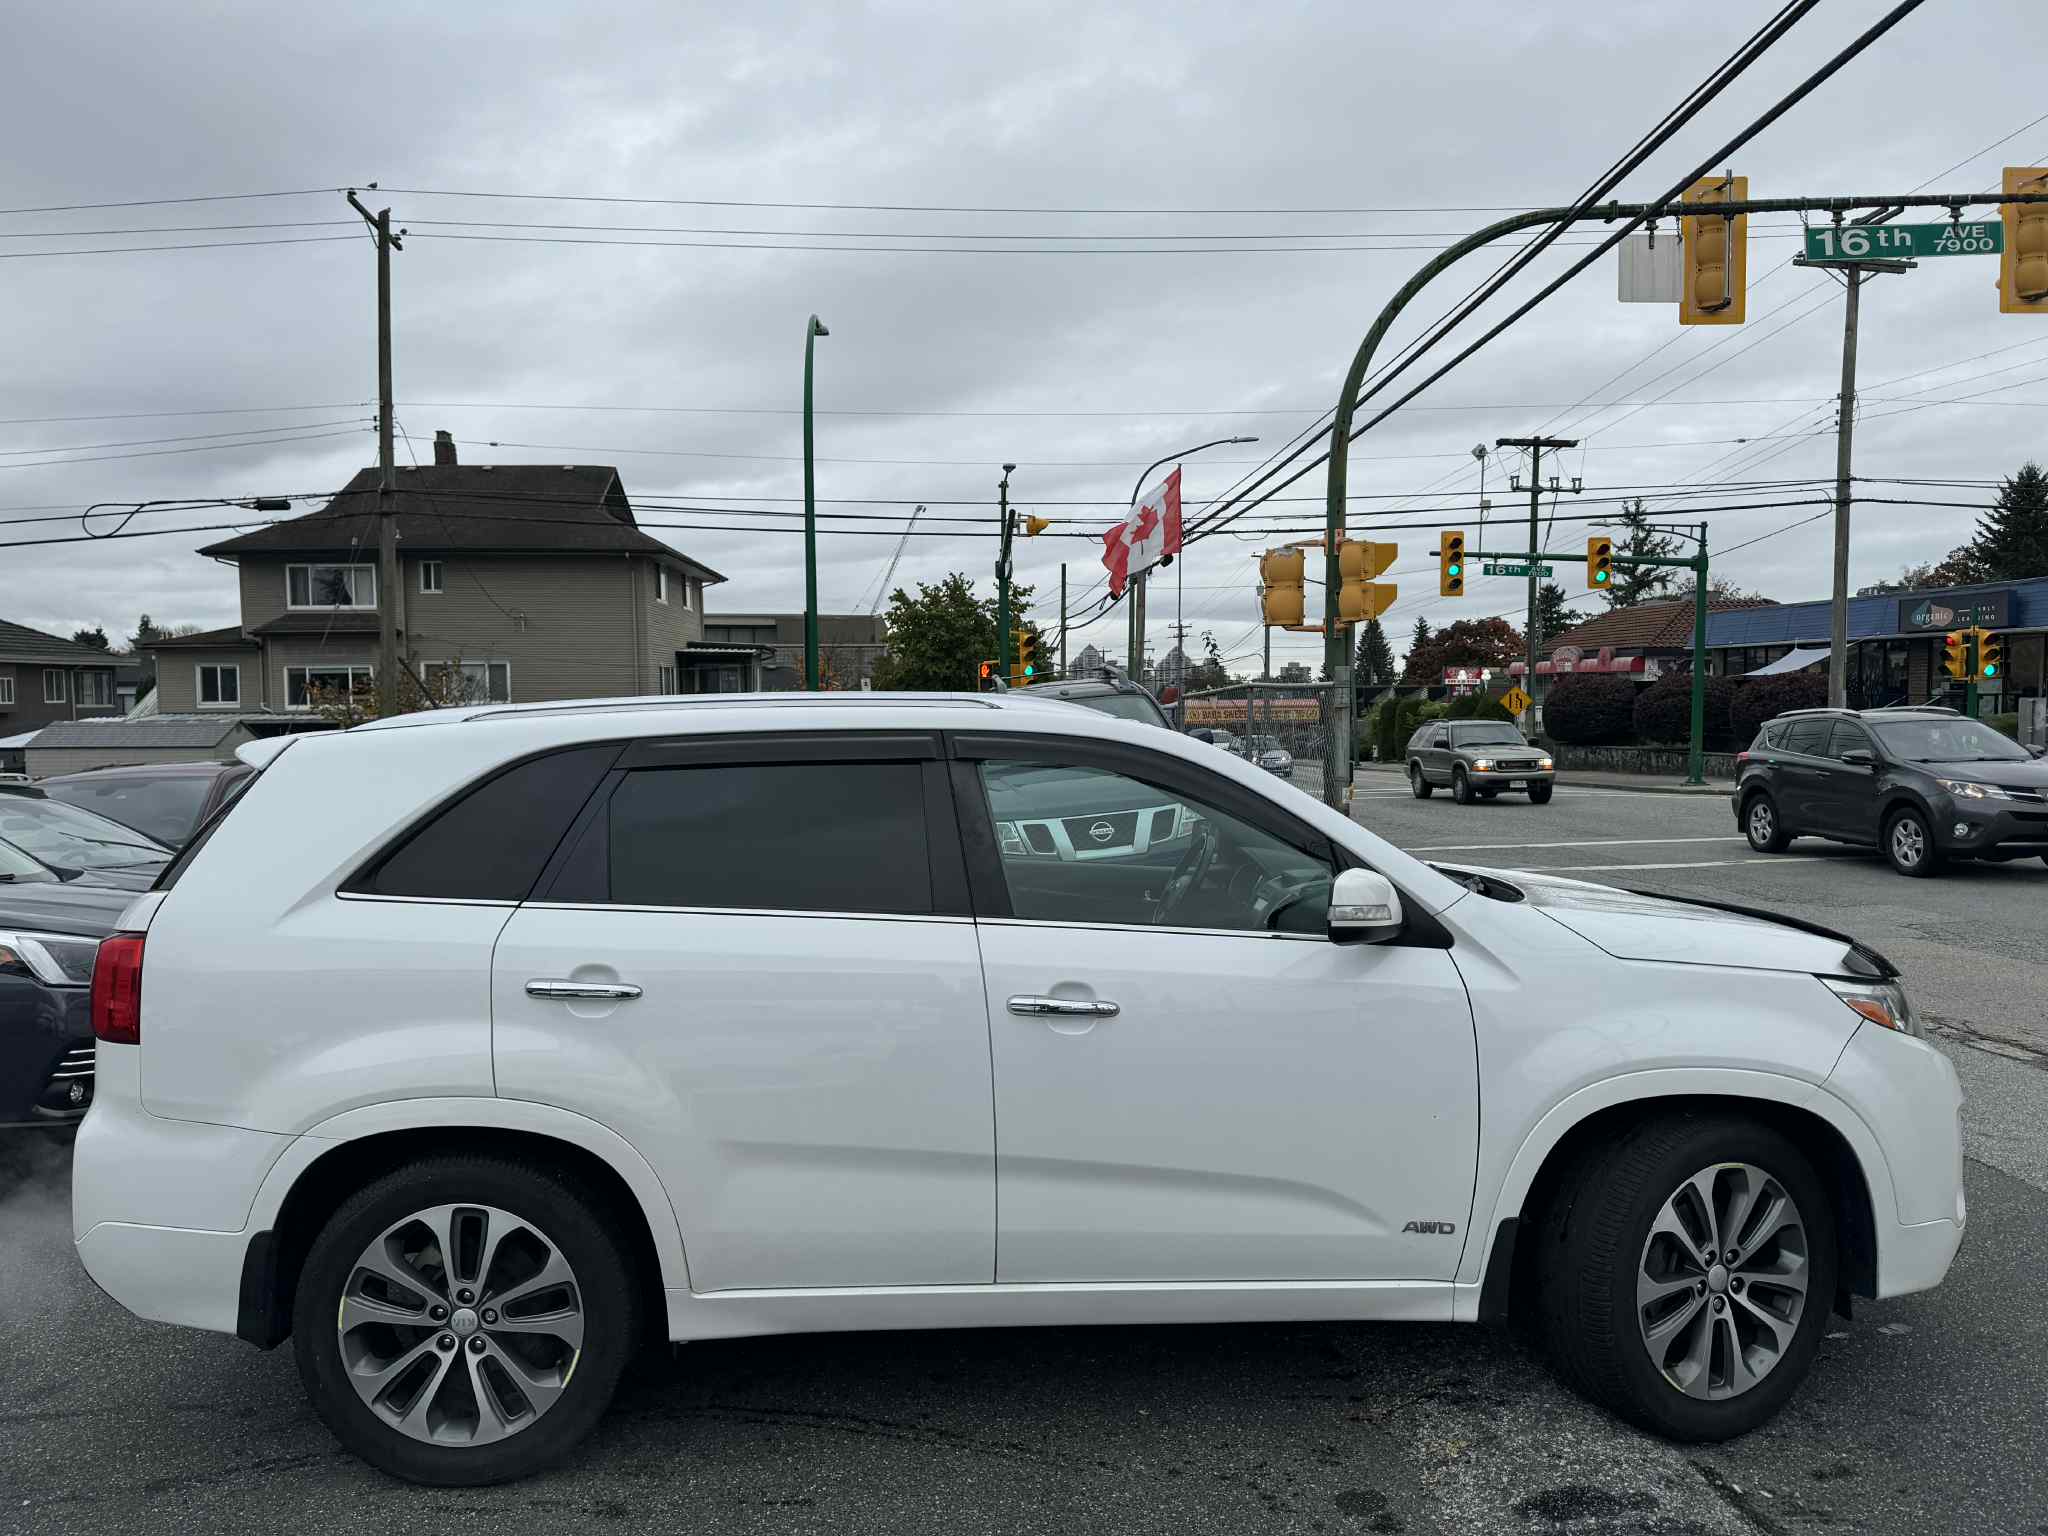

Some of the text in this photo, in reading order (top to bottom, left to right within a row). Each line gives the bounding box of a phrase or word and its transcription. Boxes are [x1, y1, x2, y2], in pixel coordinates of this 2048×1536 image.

[1942, 225, 1986, 238] AVE
[1815, 228, 1911, 256] 16th
[1934, 238, 1994, 252] 7900
[1486, 565, 1521, 575] 16th
[1916, 612, 1948, 623] organic
[1401, 1220, 1456, 1234] AWD
